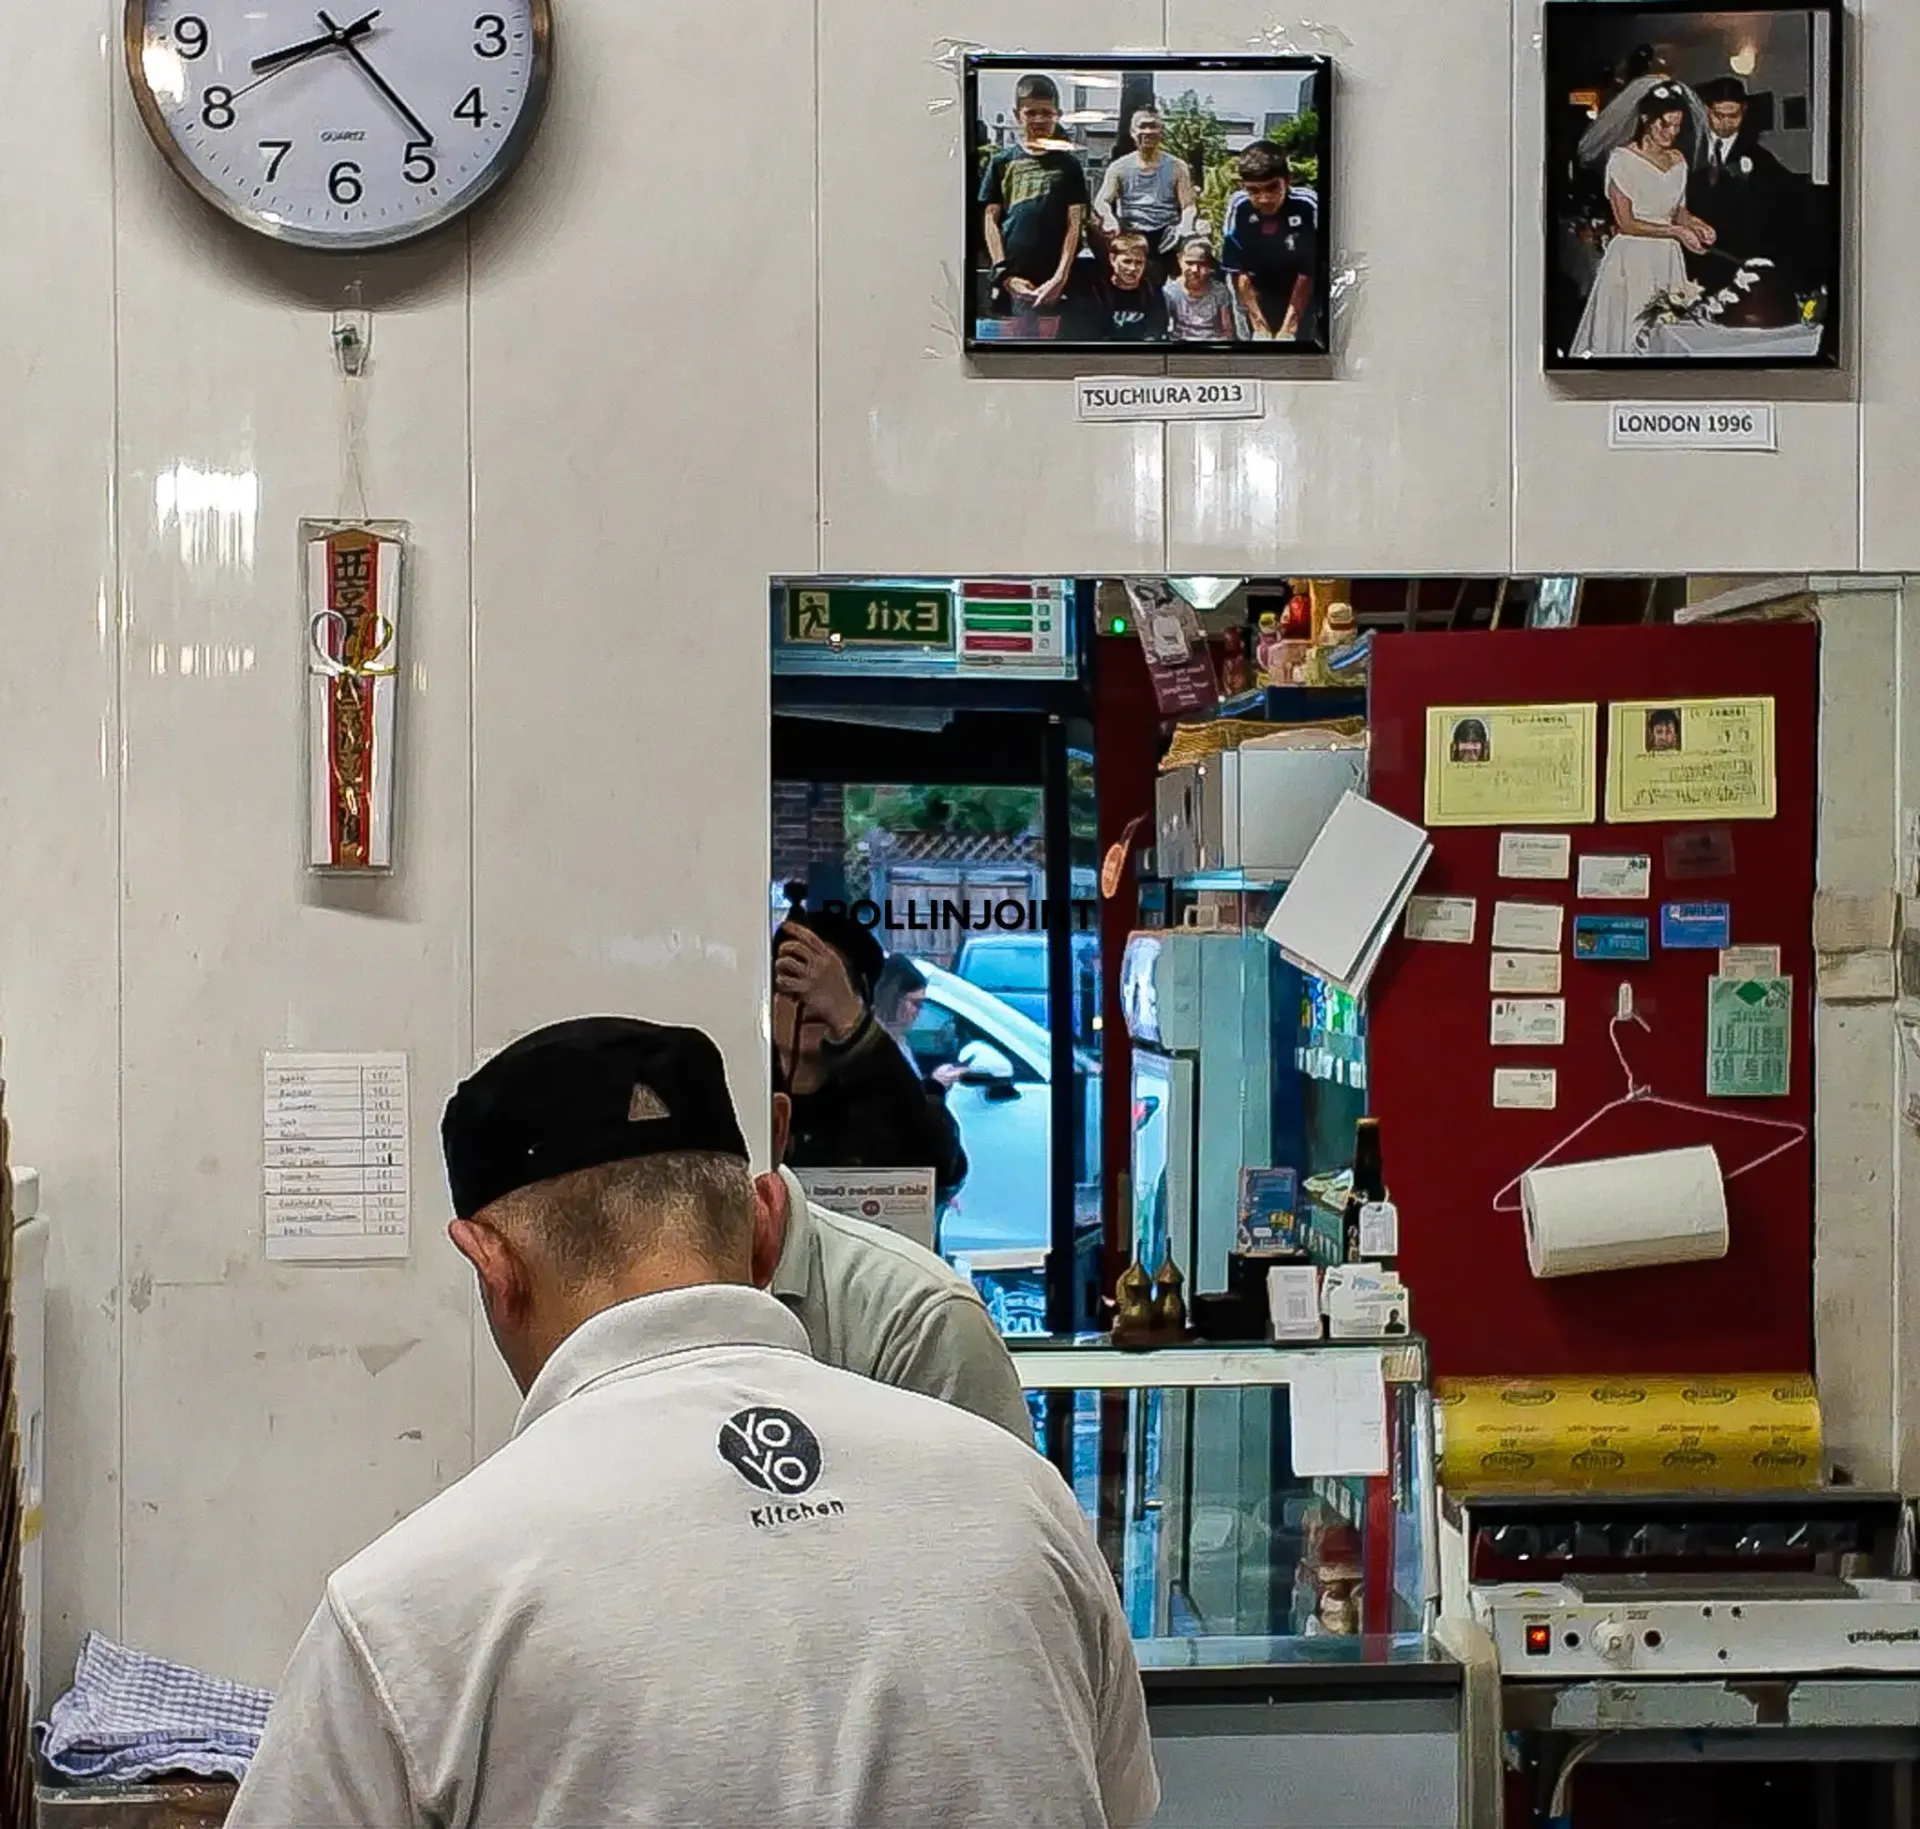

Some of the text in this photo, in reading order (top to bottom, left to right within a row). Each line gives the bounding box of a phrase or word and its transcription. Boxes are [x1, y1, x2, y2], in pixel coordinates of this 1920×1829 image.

[174, 15, 209, 60] 9
[473, 14, 507, 58] 3
[202, 85, 236, 130] 8
[453, 88, 488, 128] 4
[258, 140, 293, 183] 7
[328, 161, 362, 205] 6
[403, 141, 436, 184] 5
[1083, 385, 1243, 406] TSUCHIURA 2013
[1618, 415, 1753, 432] LONDON 1996
[750, 1500, 845, 1528] Kitchen
